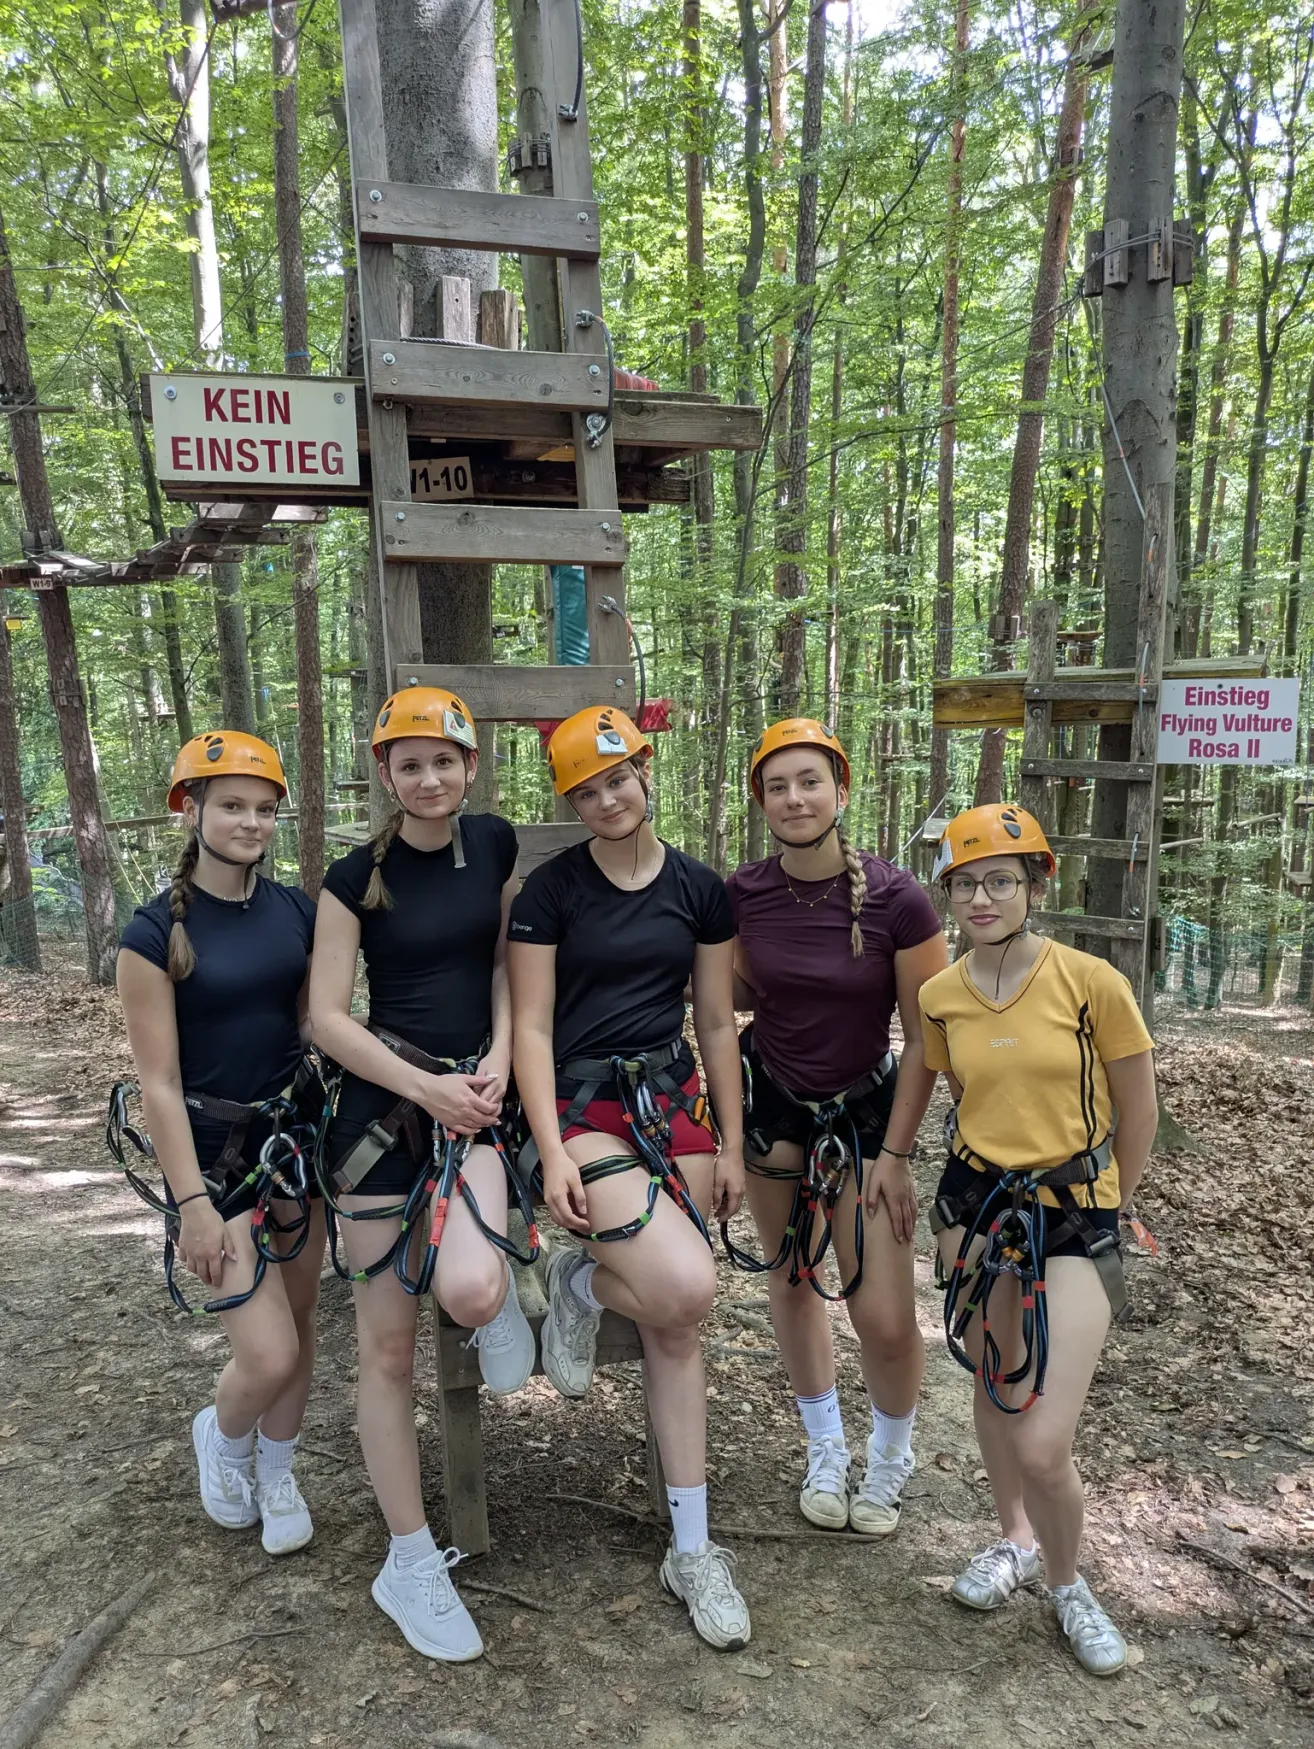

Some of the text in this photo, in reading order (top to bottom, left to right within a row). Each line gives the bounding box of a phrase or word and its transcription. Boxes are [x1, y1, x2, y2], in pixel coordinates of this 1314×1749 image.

[203, 387, 291, 425] KEIN
[171, 436, 344, 475] EINSTIEG
[1184, 686, 1270, 710] Einstieg
[412, 715, 430, 723] PETZL
[1161, 713, 1293, 736] Flying Vulture
[1188, 738, 1261, 758] Rosa II
[963, 837, 981, 848] PETZL
[990, 1037, 1019, 1048] ESPRIT
